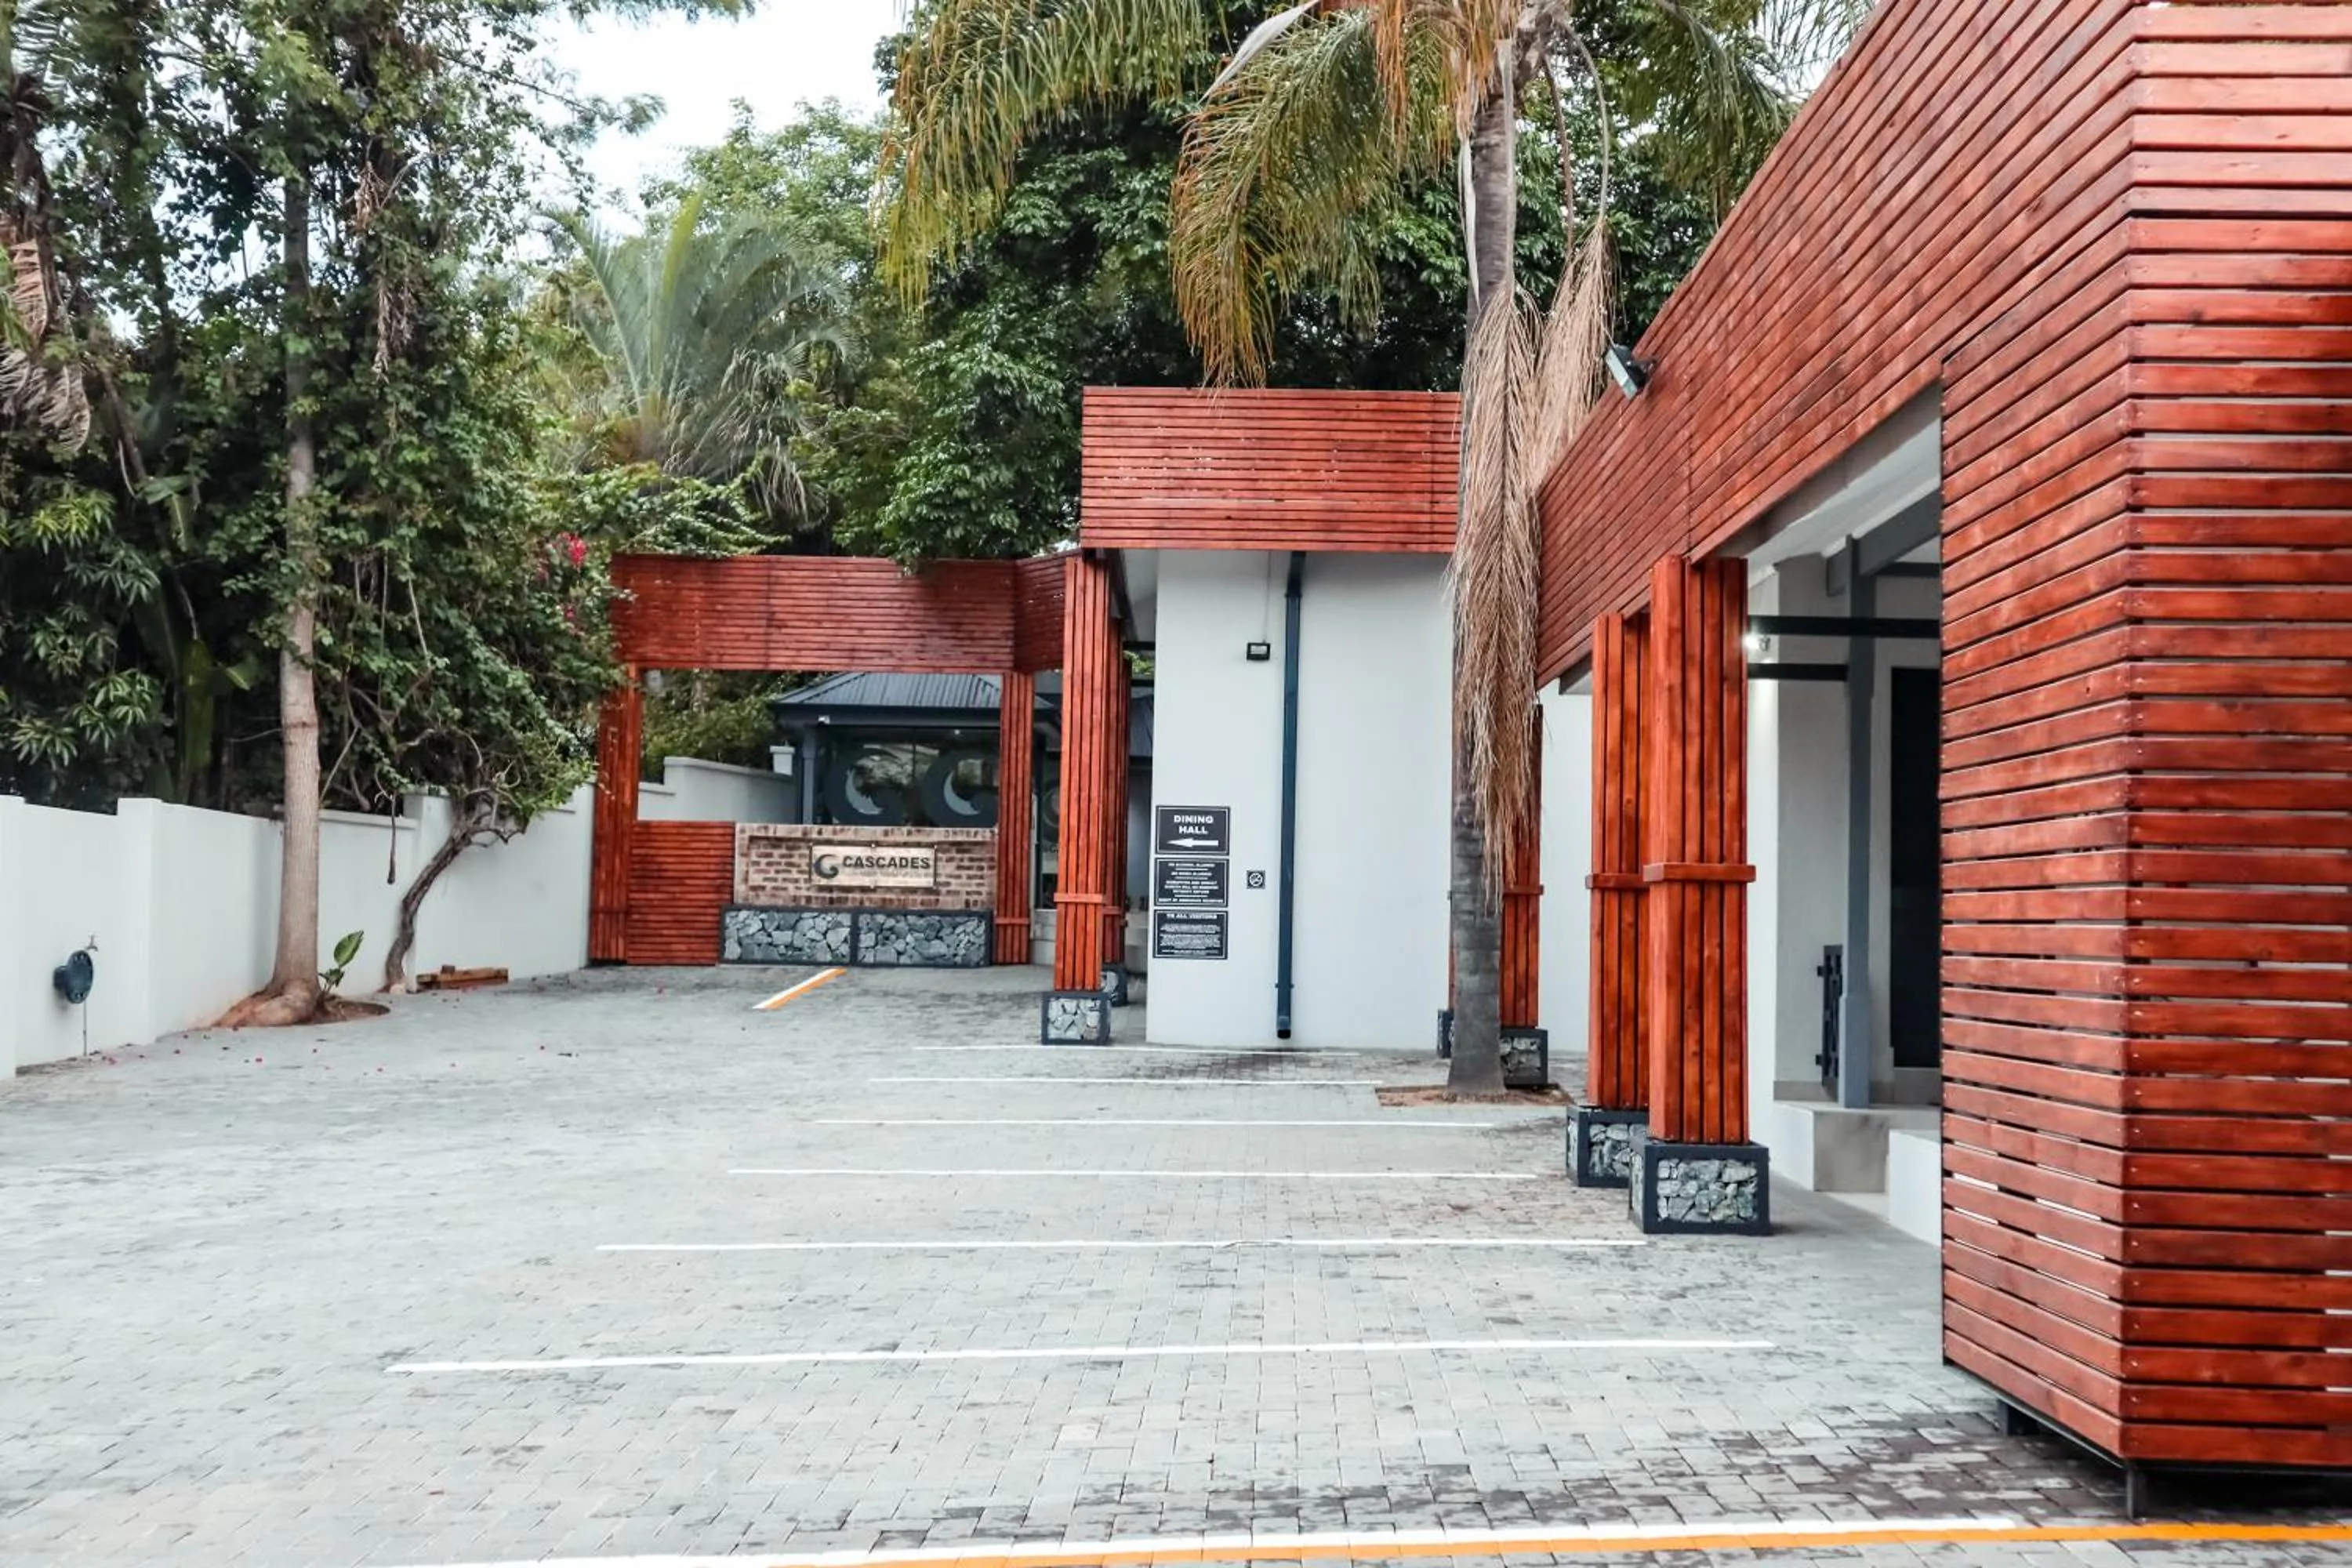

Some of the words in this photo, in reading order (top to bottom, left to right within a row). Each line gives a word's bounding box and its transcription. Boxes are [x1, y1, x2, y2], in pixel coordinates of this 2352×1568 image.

[1174, 815, 1214, 824] DINING
[1178, 826, 1209, 835] HALL
[842, 855, 931, 869] CASCADES
